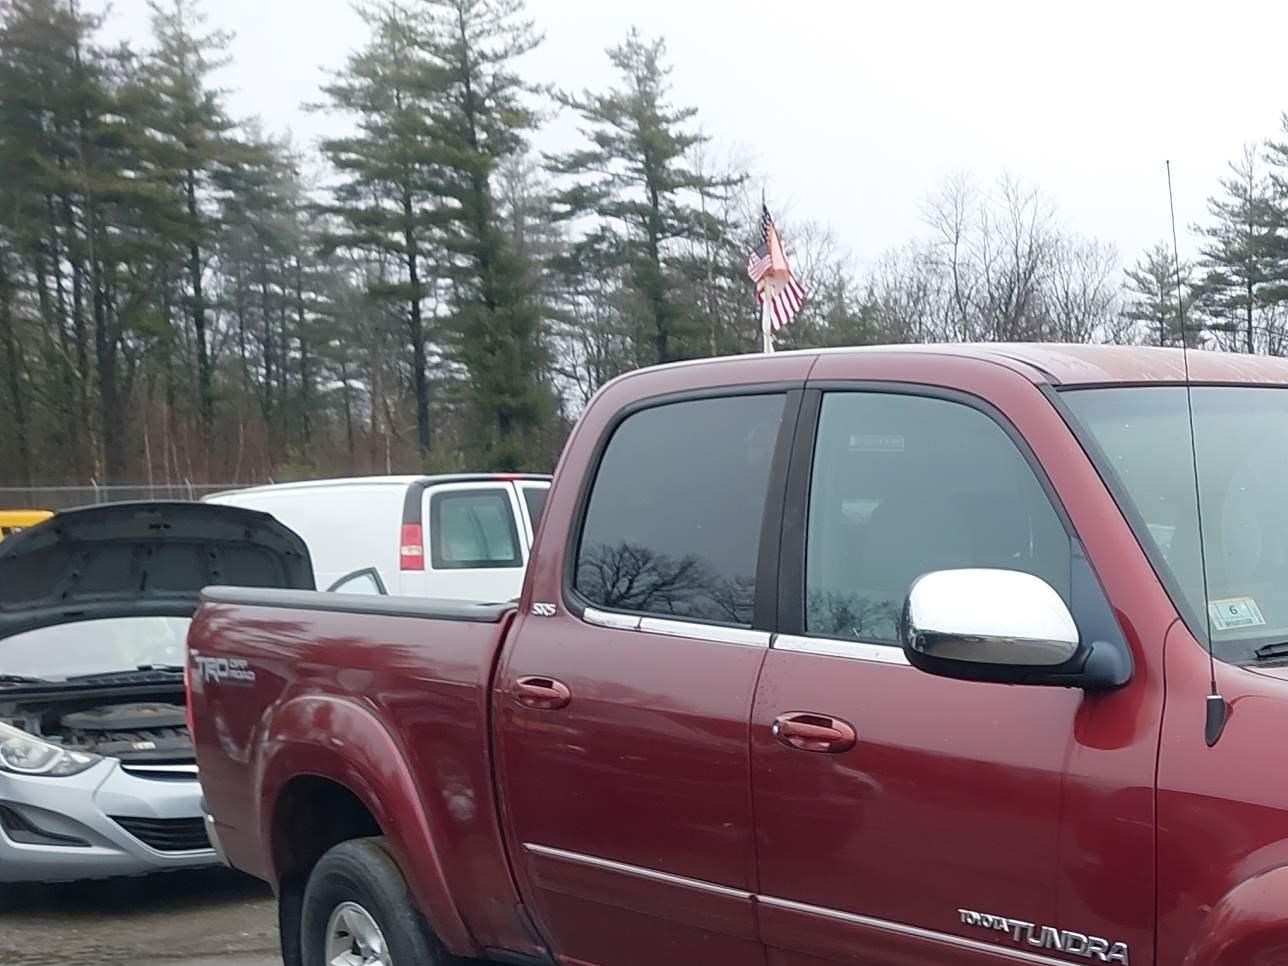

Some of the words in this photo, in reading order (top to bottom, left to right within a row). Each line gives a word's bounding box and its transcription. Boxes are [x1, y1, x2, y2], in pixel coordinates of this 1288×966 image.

[1229, 604, 1239, 615] 6
[194, 655, 229, 683] TRD
[957, 908, 1010, 933] TOYOTA
[1006, 919, 1130, 966] TUNDRA
